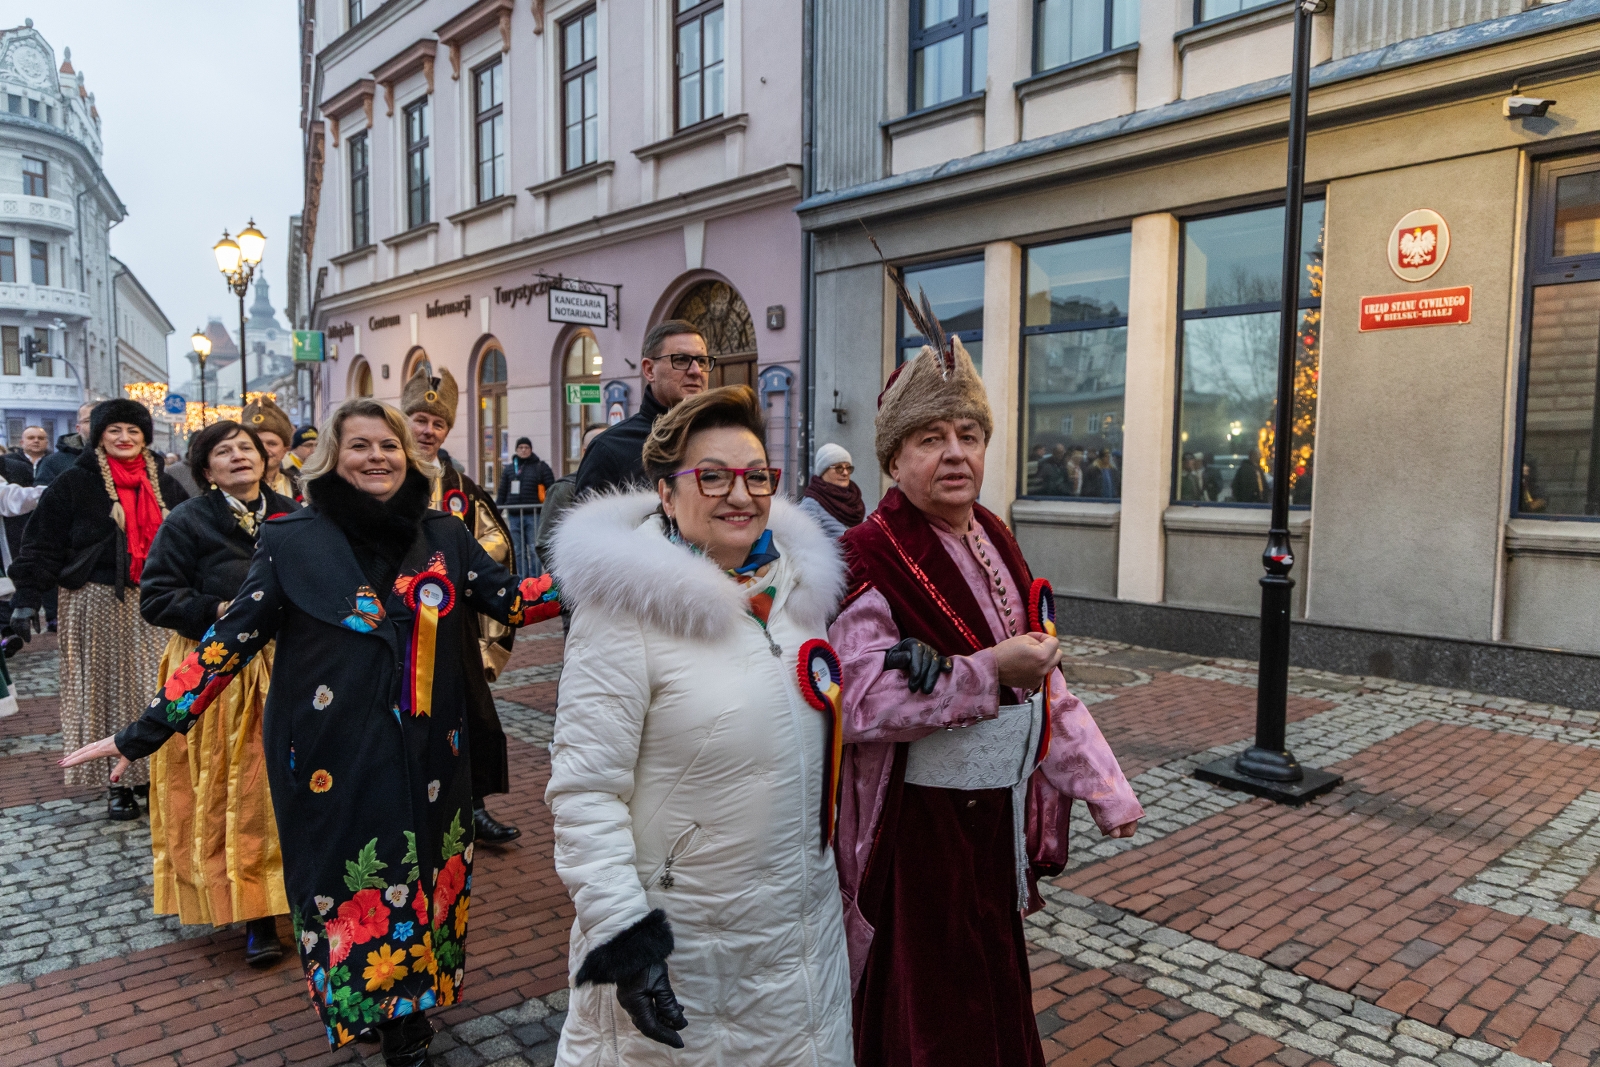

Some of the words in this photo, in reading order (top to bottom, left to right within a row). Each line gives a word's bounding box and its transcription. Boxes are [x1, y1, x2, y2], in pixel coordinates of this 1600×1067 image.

[554, 295, 602, 308] KANCELARIA
[1364, 303, 1390, 315] URZĄD
[1391, 299, 1418, 312] STANU
[1418, 295, 1466, 310] CYWILNEGO
[369, 314, 401, 331] Centrum
[426, 295, 471, 318] Informacji
[554, 307, 602, 320] NOTARIALNA
[1374, 314, 1382, 322] W
[1383, 308, 1453, 322] BIELSKU-BIAŁEJ
[771, 314, 777, 326] 4
